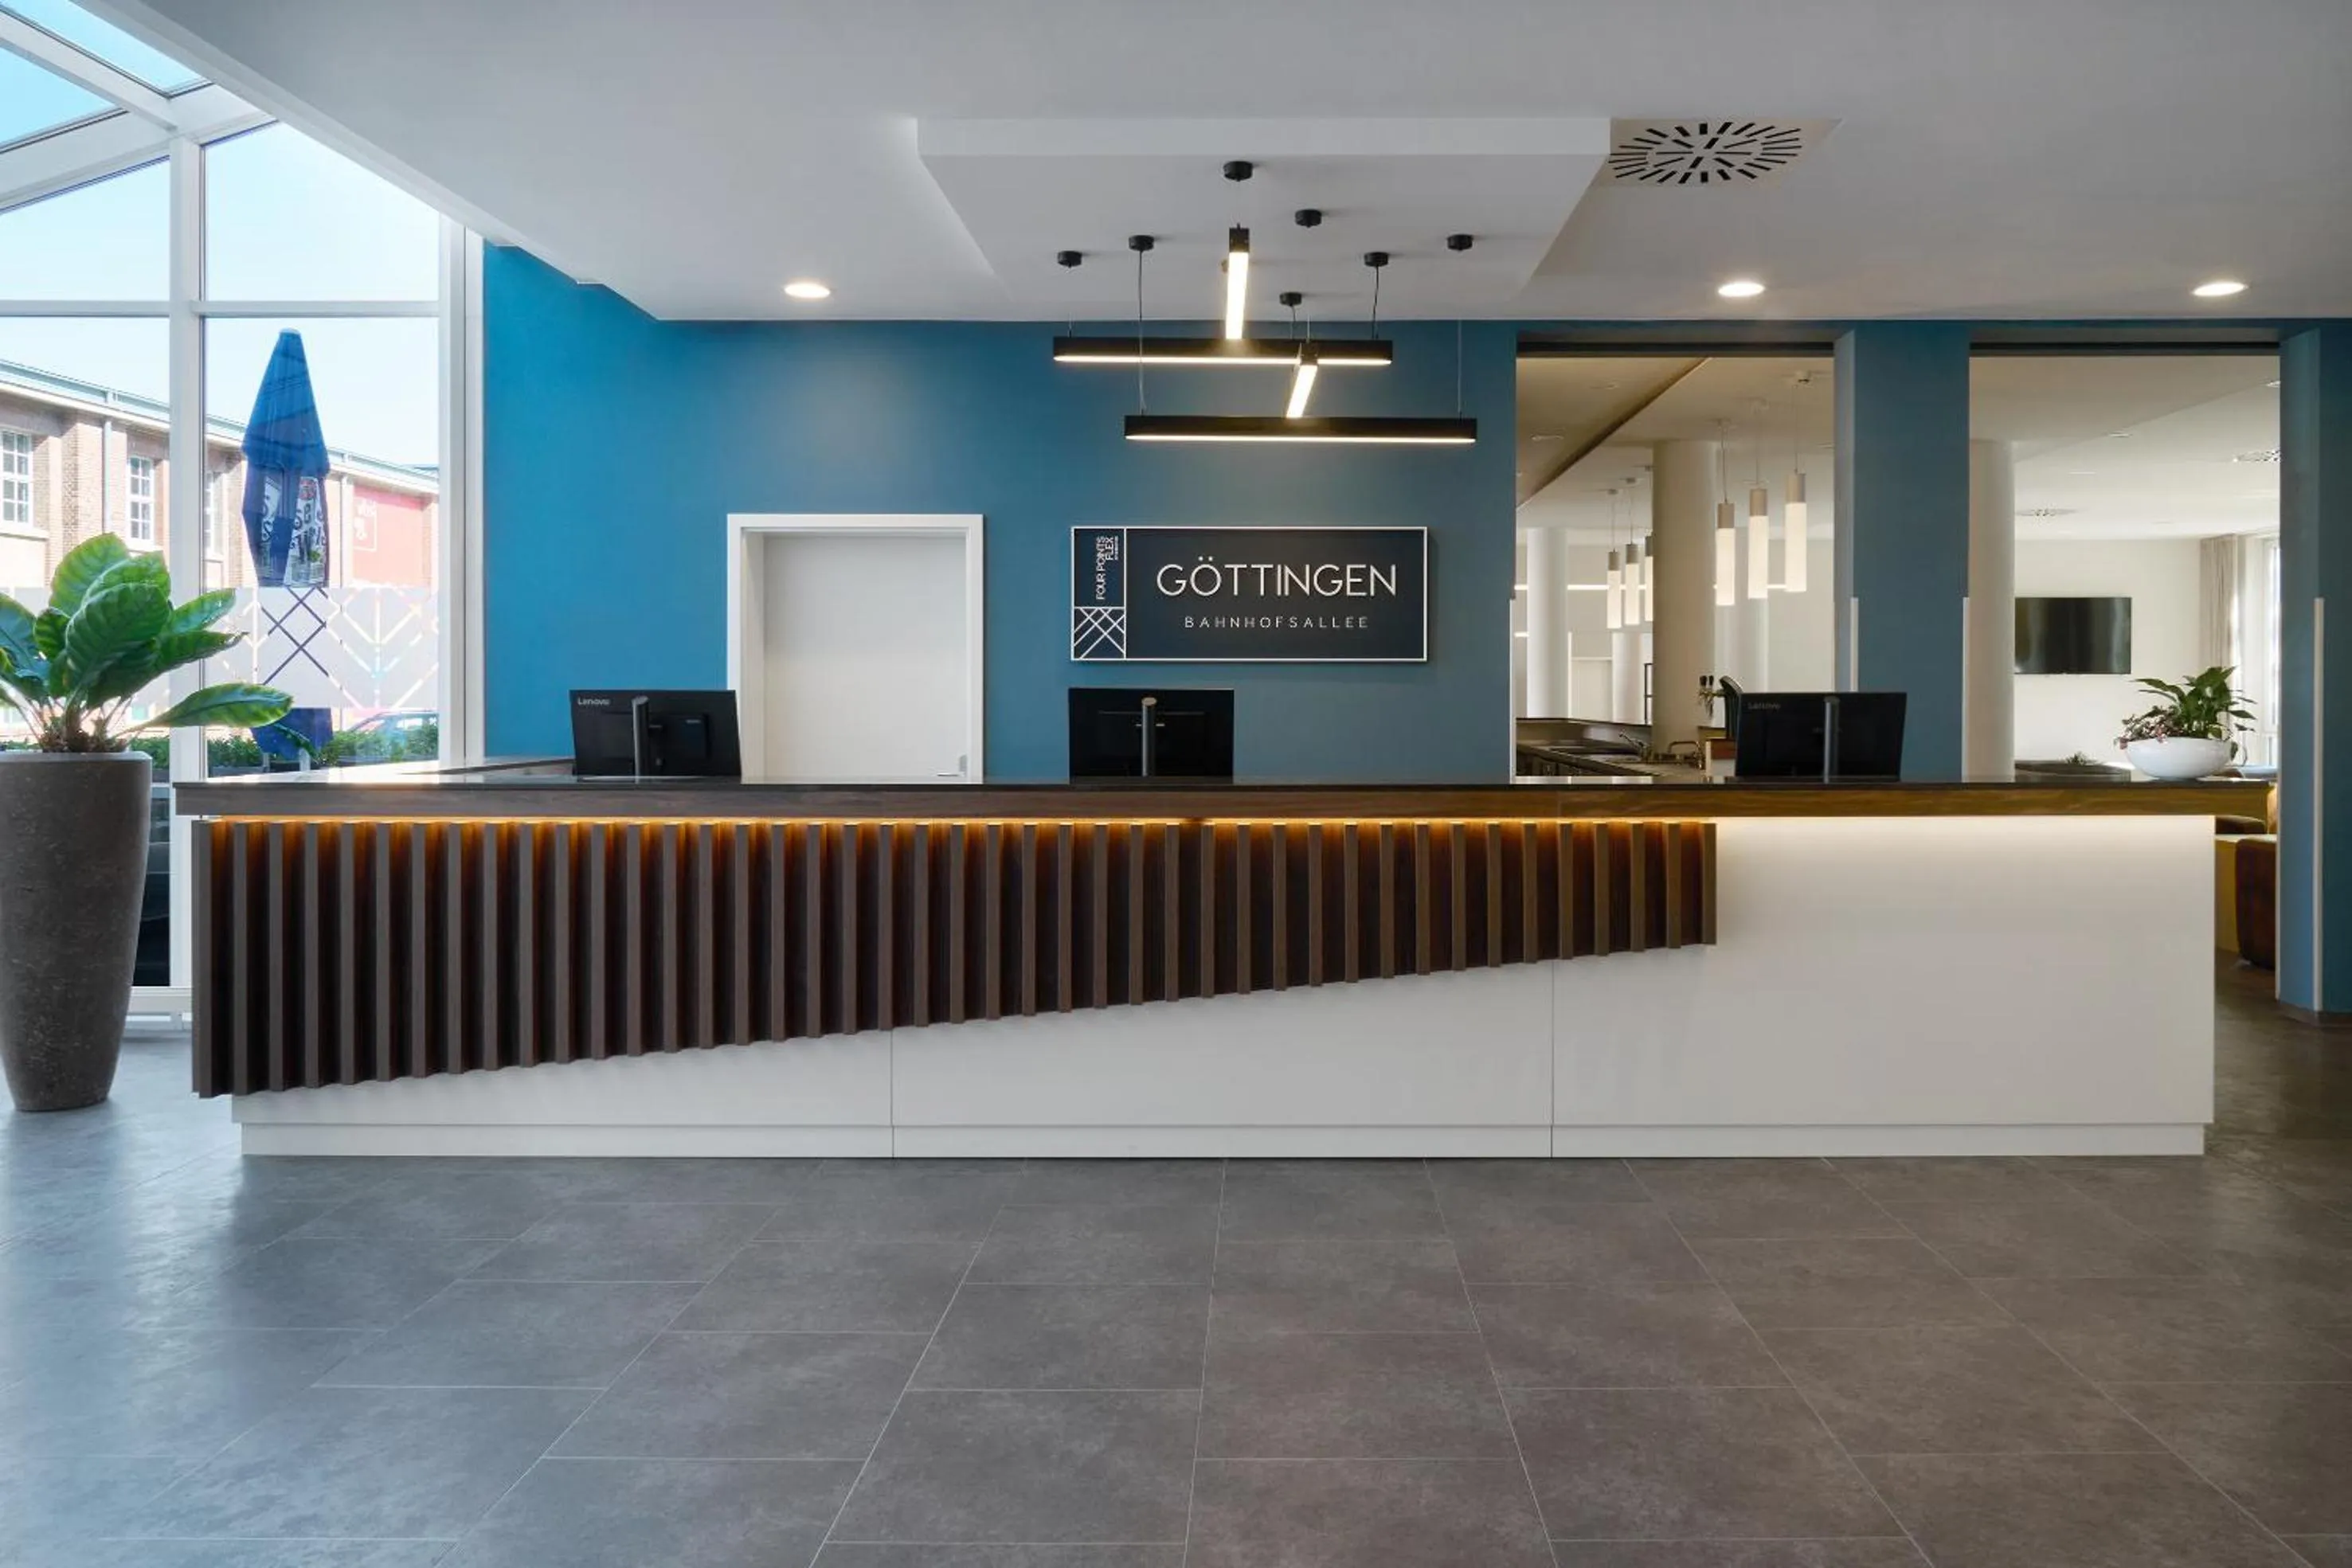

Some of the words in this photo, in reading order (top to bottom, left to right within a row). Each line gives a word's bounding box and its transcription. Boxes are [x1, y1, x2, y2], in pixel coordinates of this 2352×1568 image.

[1096, 536, 1106, 571] POINTS
[1096, 573, 1106, 600] FOUR
[1156, 556, 1396, 596] GÖTTINGEN
[1184, 616, 1368, 628] BAHNHOFSALLEE
